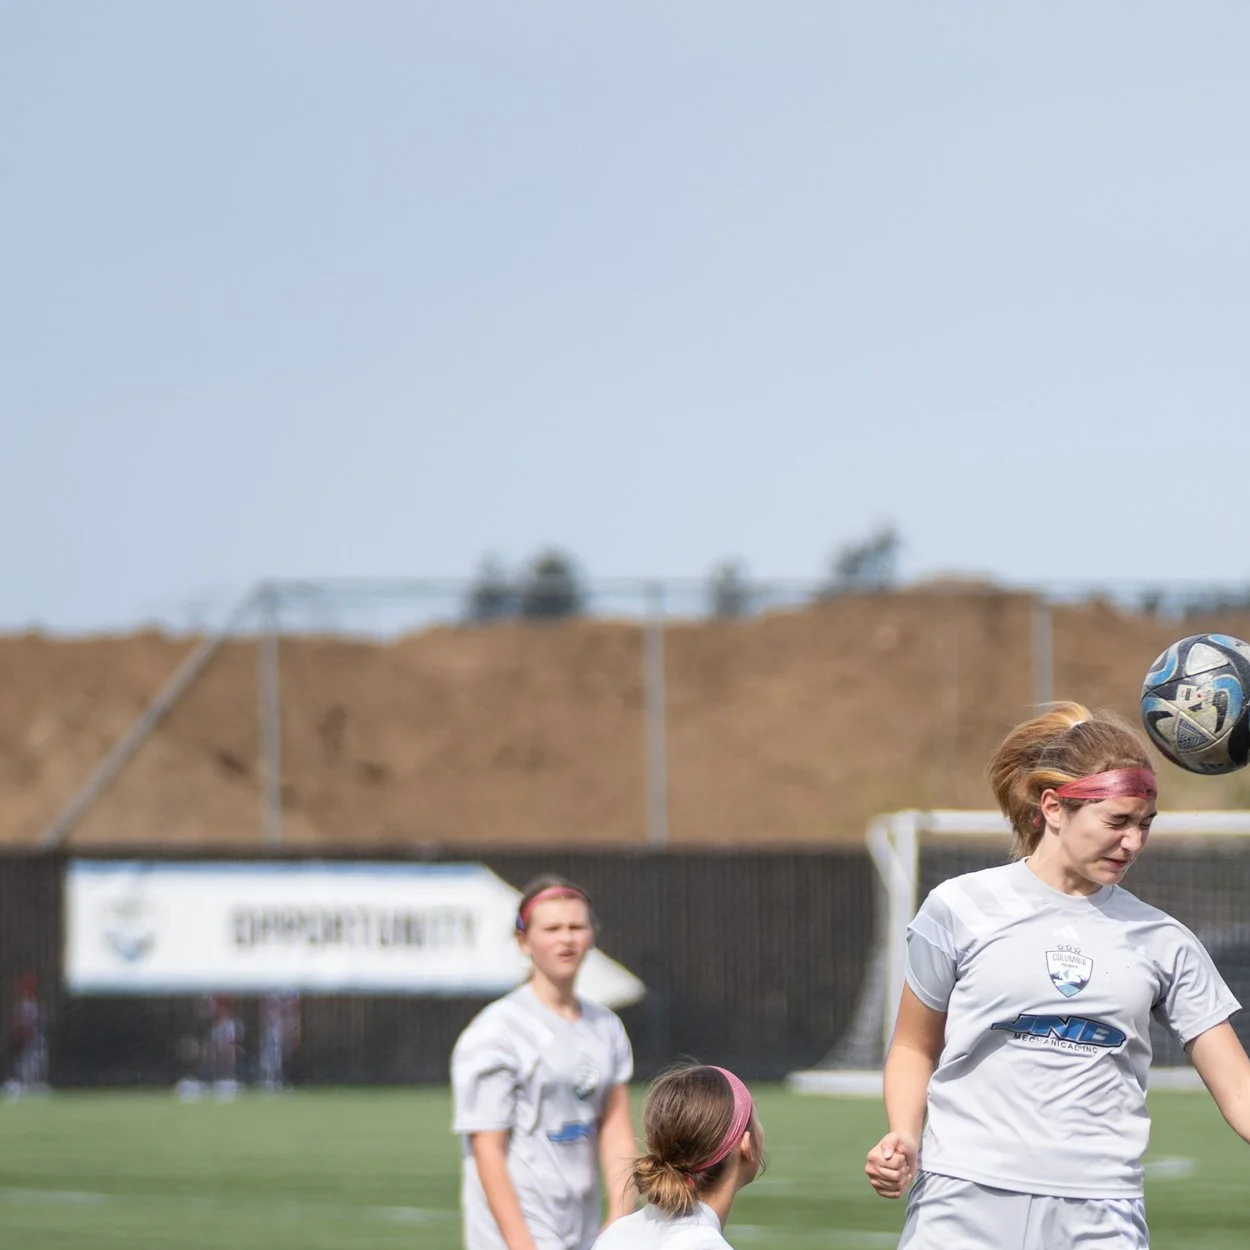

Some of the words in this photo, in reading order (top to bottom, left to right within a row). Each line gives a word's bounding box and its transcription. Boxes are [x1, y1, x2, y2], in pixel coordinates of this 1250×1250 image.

[232, 904, 479, 949] OPPORTUNITY
[1052, 953, 1087, 966] COLUMBIA
[1013, 1033, 1079, 1052] MECHANICAL
